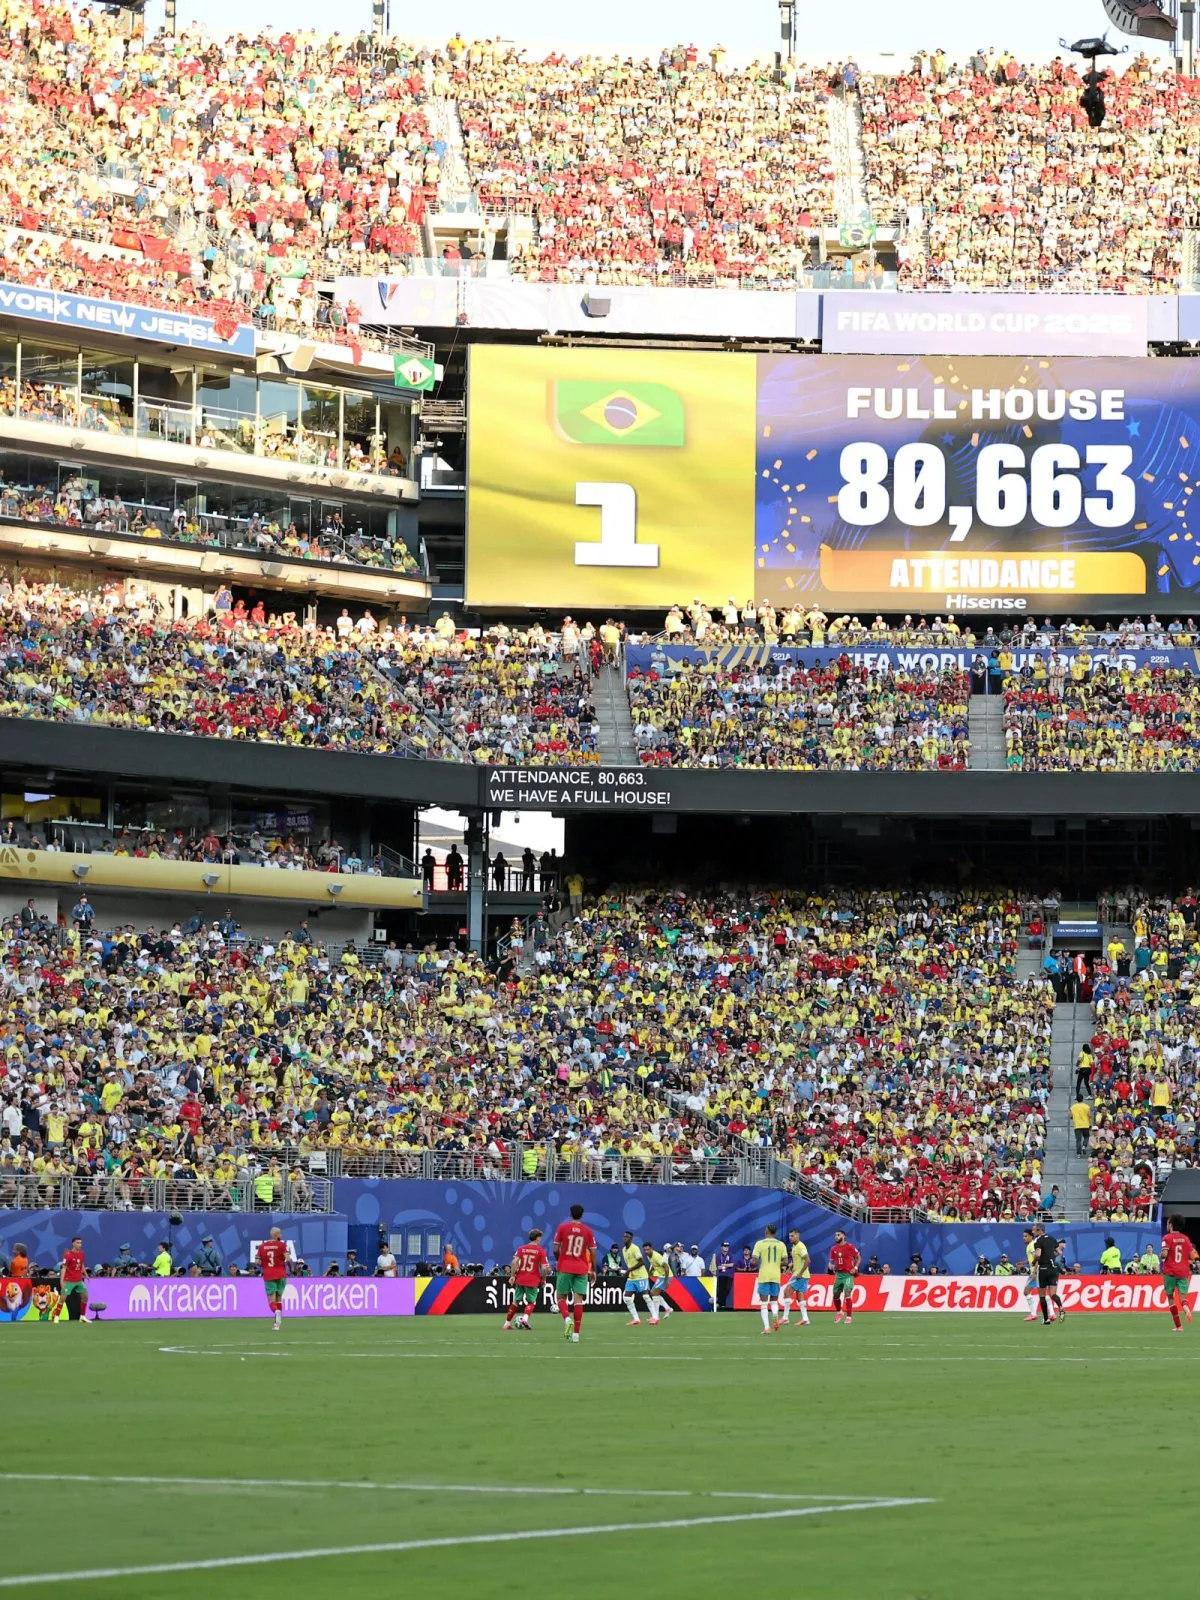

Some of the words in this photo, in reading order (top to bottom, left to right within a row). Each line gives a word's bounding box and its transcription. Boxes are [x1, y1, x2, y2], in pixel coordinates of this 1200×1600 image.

[0, 291, 71, 317] YORK
[77, 303, 136, 328] NEW
[837, 312, 890, 332] FIFA
[894, 312, 987, 333] WORLD
[990, 313, 1040, 334] CUP
[1044, 314, 1133, 335] 2026
[847, 387, 957, 419] FULL
[971, 388, 1126, 421] HOUSE
[837, 441, 1137, 542] 80,663
[574, 482, 659, 567] 1
[889, 558, 1075, 588] ATTENDANCE
[946, 594, 1027, 609] Hisense
[772, 652, 791, 661] 221A
[1150, 655, 1170, 664] 222A
[490, 771, 594, 785] ATTENDANCE,
[598, 773, 648, 785] 80,663.
[490, 789, 514, 802] WE
[519, 790, 557, 803] HAVE
[560, 790, 571, 803] A
[574, 791, 610, 803] FULL
[614, 792, 671, 805] HOUSE!
[566, 1235, 584, 1257] 18
[767, 1245, 777, 1263] 11
[1175, 1245, 1182, 1263] 6
[267, 1251, 275, 1267] 3
[521, 1254, 536, 1272] 15
[154, 1284, 237, 1311] kraken
[301, 1283, 378, 1310] kraken
[901, 1279, 1019, 1309] Betano
[1054, 1279, 1175, 1312] Betano
